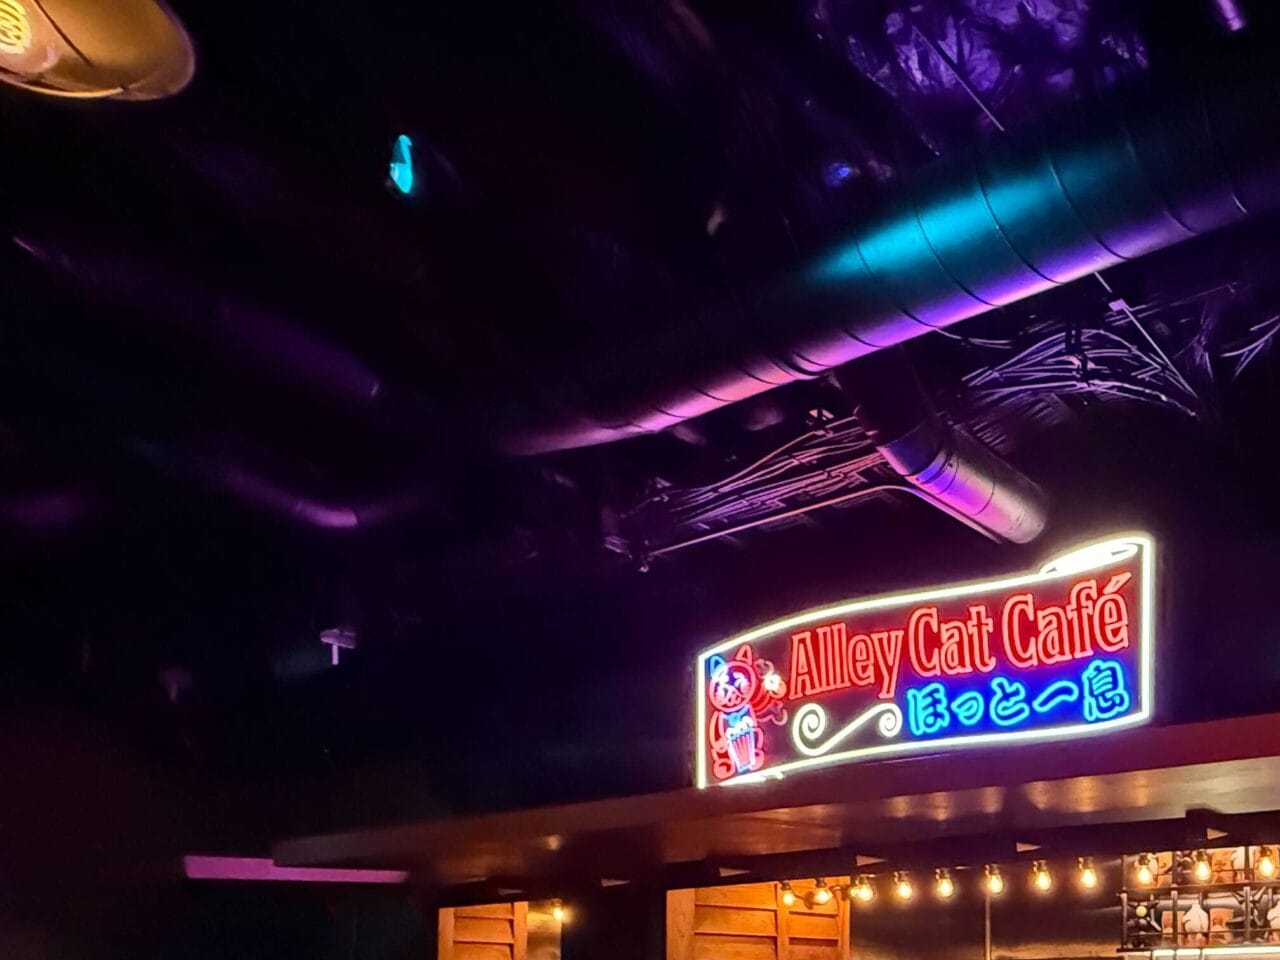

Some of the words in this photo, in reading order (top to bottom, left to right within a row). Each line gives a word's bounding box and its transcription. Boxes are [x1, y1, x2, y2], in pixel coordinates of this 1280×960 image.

[788, 621, 904, 701] Alley
[907, 604, 996, 679] Cat
[1001, 571, 1133, 668] Café
